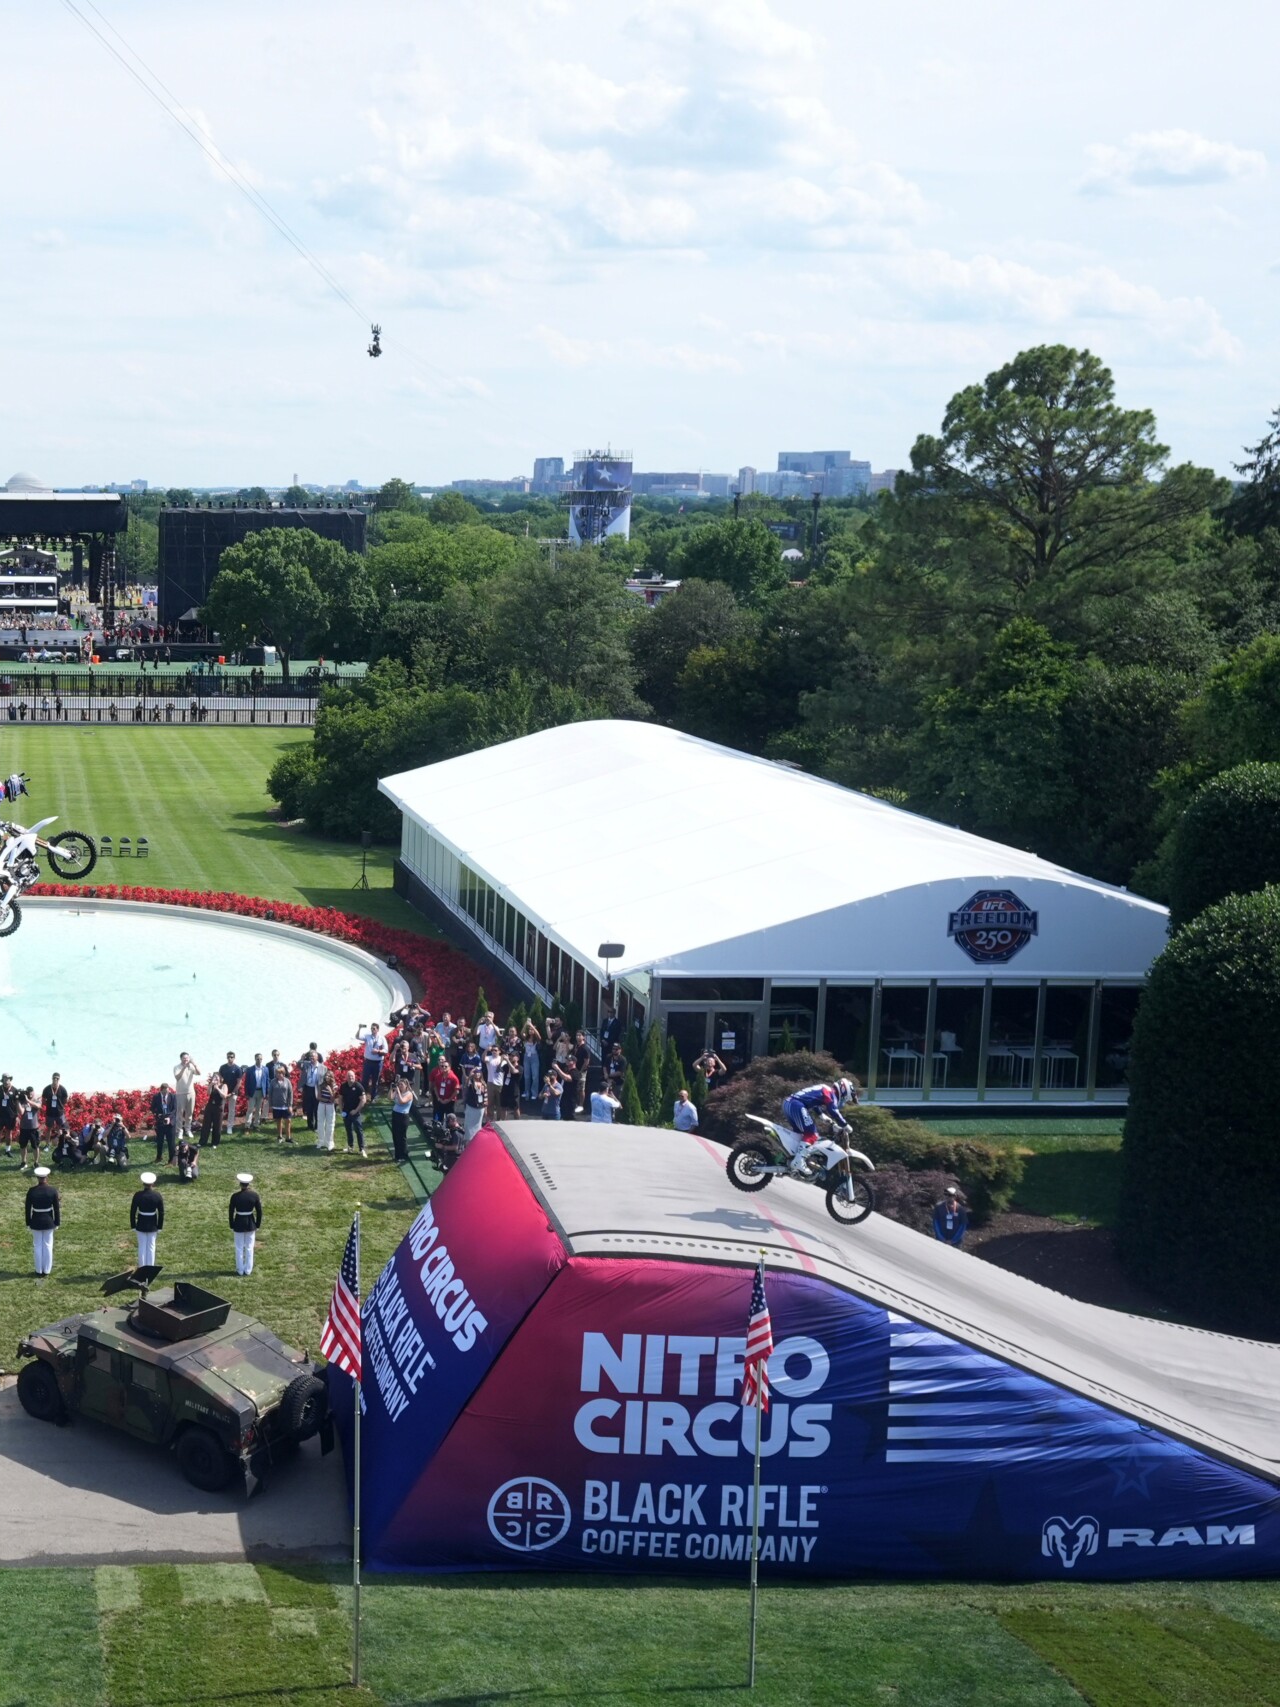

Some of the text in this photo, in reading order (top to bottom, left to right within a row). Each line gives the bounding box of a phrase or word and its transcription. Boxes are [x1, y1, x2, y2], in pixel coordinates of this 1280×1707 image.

[949, 911, 1038, 932] FREEDOM
[982, 902, 1007, 911] UFC
[975, 931, 1012, 950] 250
[377, 1271, 409, 1345] BLACK
[420, 1245, 489, 1352] CIRCUS
[374, 1347, 410, 1423] COMPANY
[573, 1397, 833, 1458] CIRCUS
[584, 1479, 708, 1526] BLACK
[581, 1528, 818, 1563] COFFEE COMPANY
[1107, 1524, 1256, 1548] RAM
